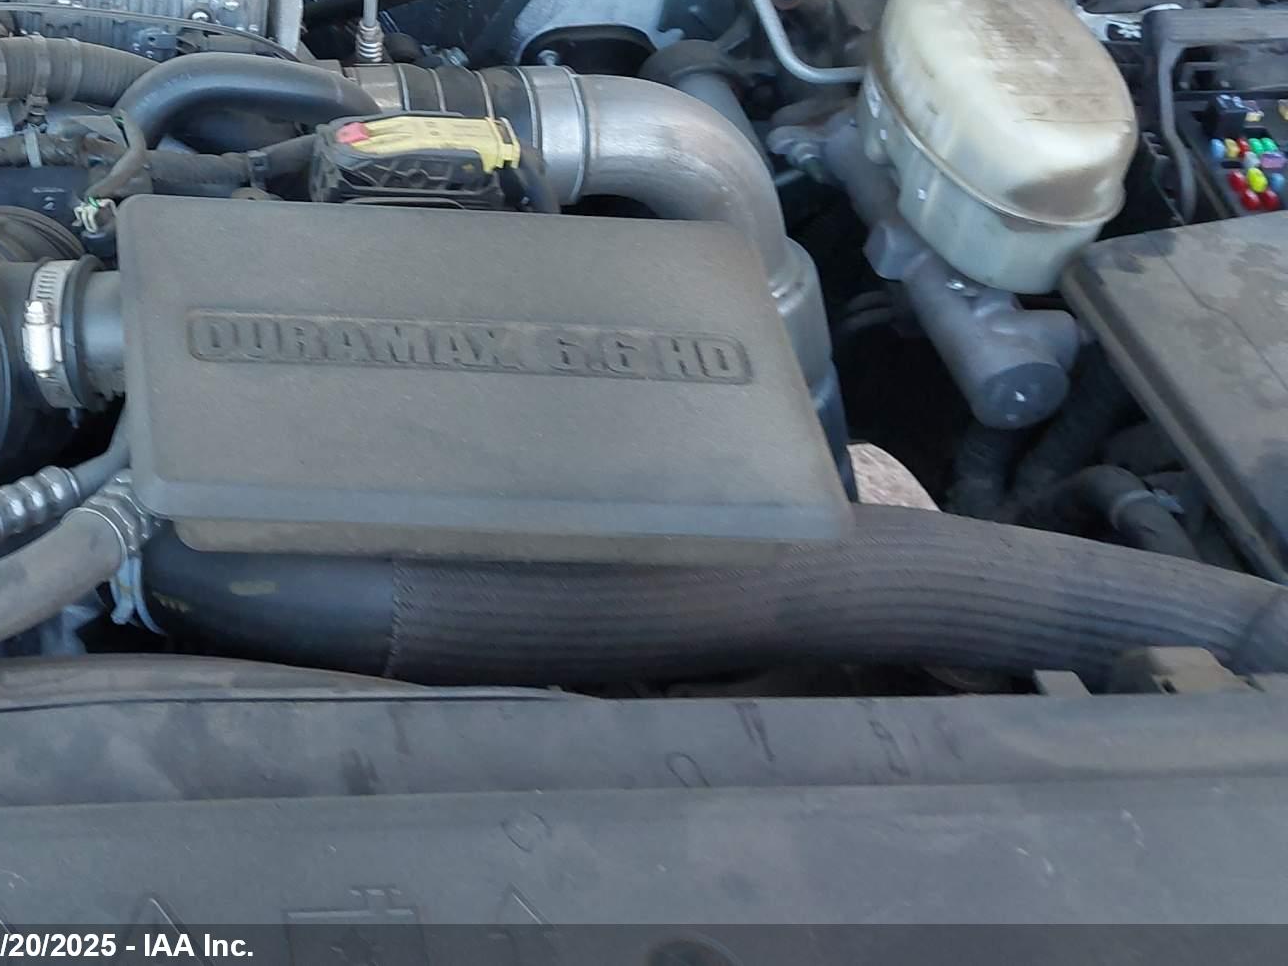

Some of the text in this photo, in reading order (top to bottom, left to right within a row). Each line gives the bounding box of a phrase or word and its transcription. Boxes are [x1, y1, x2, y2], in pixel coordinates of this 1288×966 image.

[192, 314, 748, 382] DURAMAX 6.6 HD
